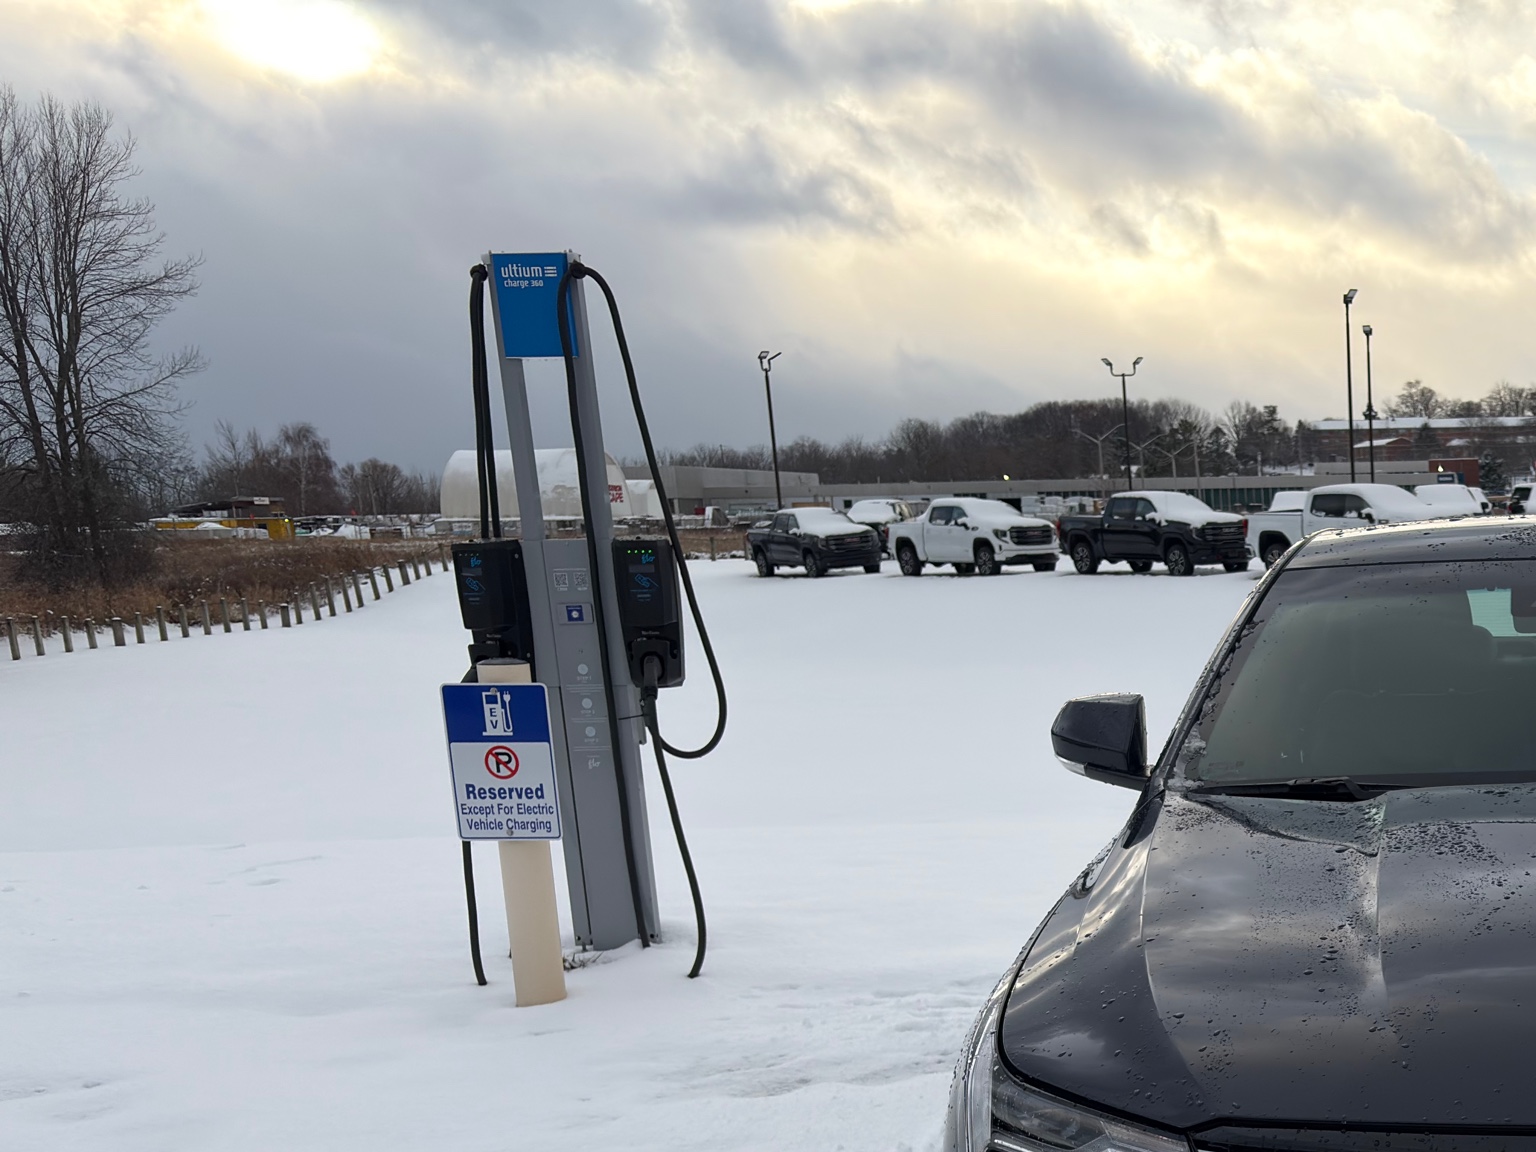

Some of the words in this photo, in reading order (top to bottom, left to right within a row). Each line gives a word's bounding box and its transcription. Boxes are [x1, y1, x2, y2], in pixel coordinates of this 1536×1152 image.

[501, 263, 543, 278] ultium
[504, 279, 529, 289] charge
[465, 783, 545, 800] Reserved
[461, 803, 495, 817] Except
[497, 803, 514, 815] For
[517, 803, 554, 815] Electric
[467, 818, 503, 831] Vehicle
[506, 818, 552, 833] Charging
